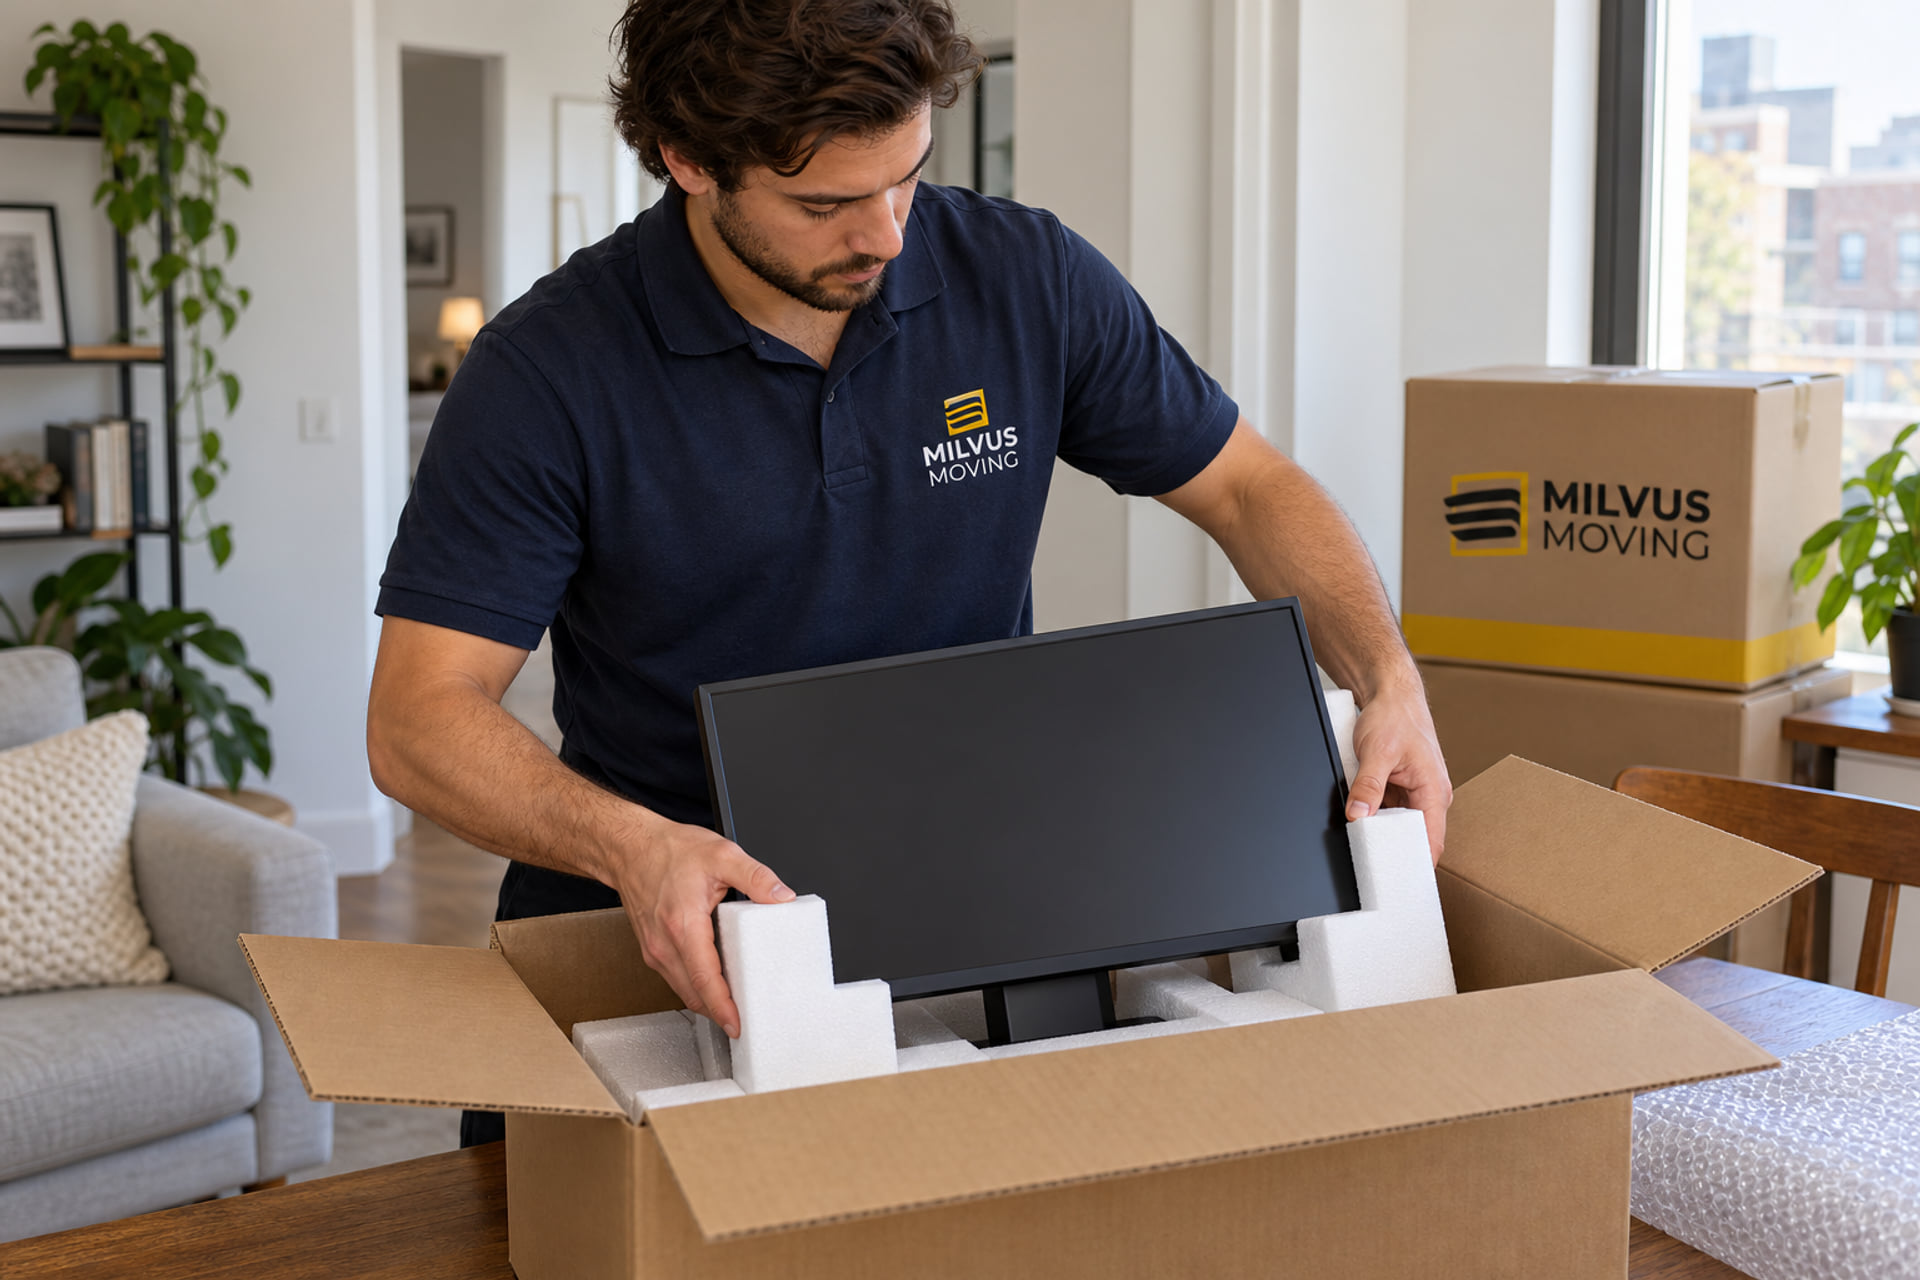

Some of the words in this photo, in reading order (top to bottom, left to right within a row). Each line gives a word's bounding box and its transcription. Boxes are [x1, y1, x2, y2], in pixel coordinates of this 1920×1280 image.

[922, 426, 1018, 467] MILVUS
[929, 451, 1019, 487] MOVING
[1543, 480, 1711, 524] MILVUS
[1543, 520, 1710, 561] MOVING
